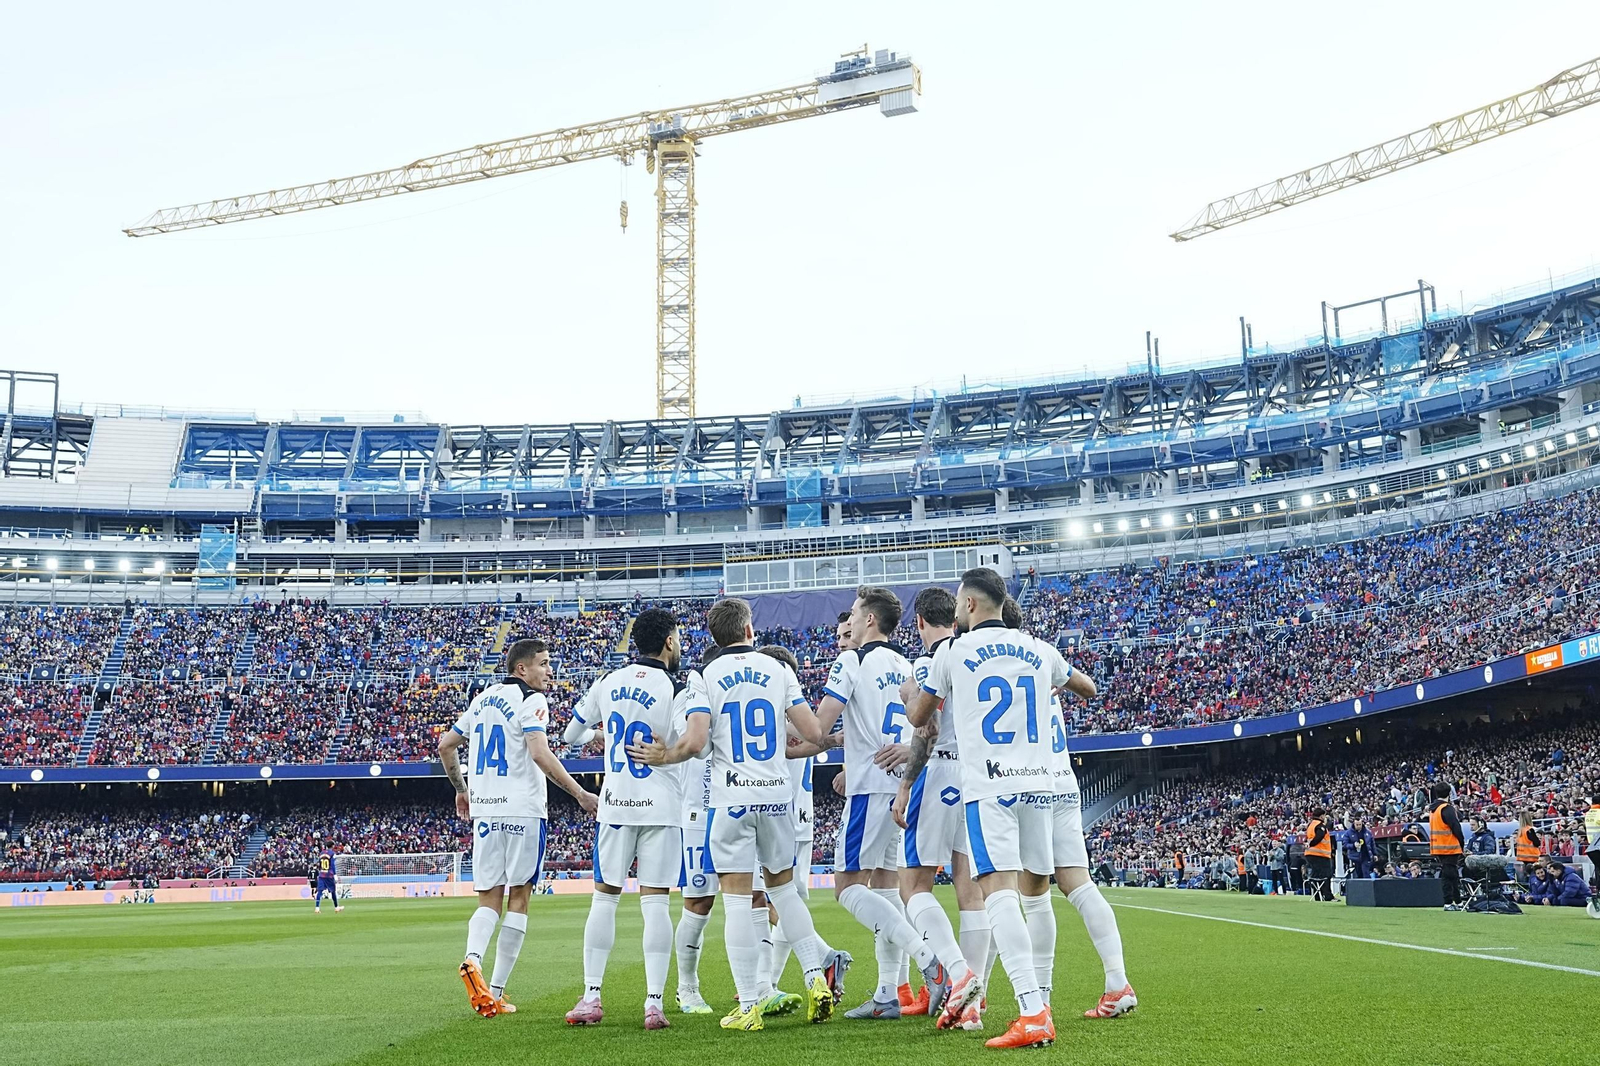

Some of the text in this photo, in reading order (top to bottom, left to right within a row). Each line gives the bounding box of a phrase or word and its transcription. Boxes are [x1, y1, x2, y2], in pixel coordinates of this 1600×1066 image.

[963, 643, 1043, 673] A.REBBACH
[876, 672, 908, 691] J.PACH
[977, 675, 1039, 745] 21
[720, 698, 777, 763] 19
[474, 722, 509, 776] 14
[725, 769, 786, 788] Kutxabank
[986, 758, 1049, 780] Kutxabank
[469, 788, 509, 805] utxabank
[605, 788, 654, 808] Kutxabank
[321, 858, 330, 870] 10
[686, 846, 705, 870] 17
